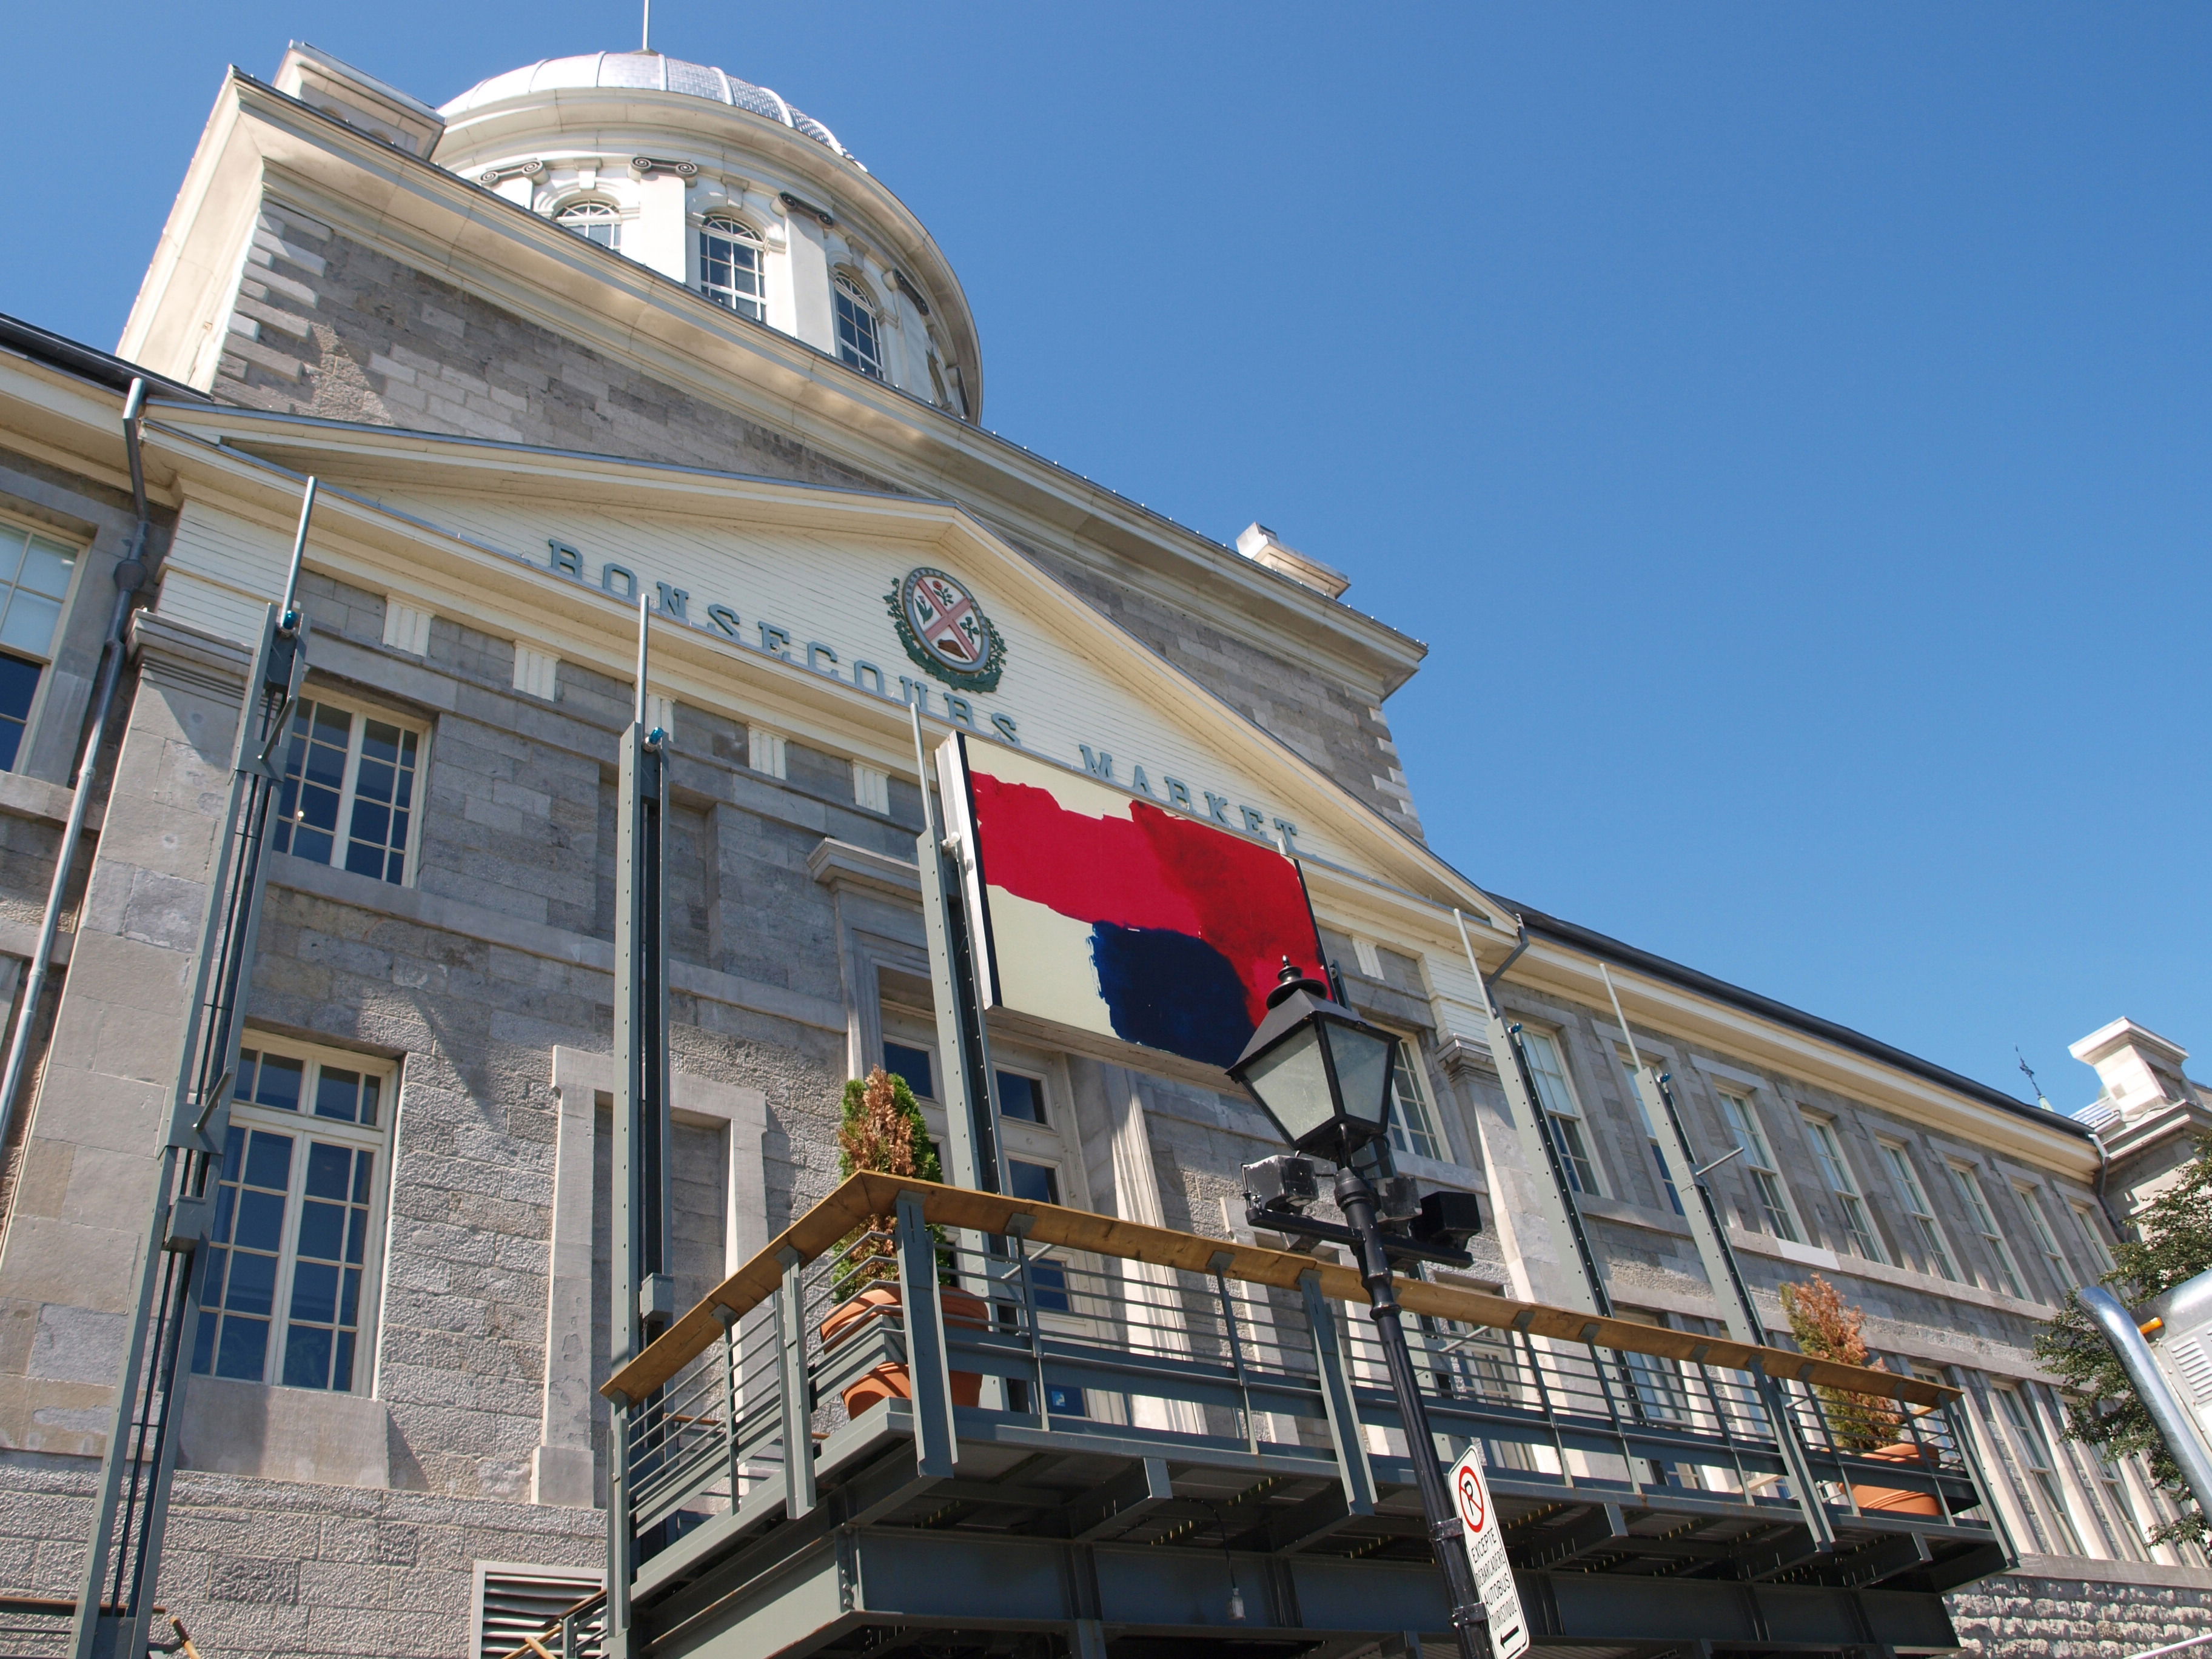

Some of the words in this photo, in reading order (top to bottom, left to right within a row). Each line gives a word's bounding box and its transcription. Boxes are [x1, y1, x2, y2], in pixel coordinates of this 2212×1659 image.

[548, 538, 1021, 746] BONSECOURS
[1079, 744, 1297, 848] MARKET
[1484, 1572, 1510, 1606] AUTOBUS
